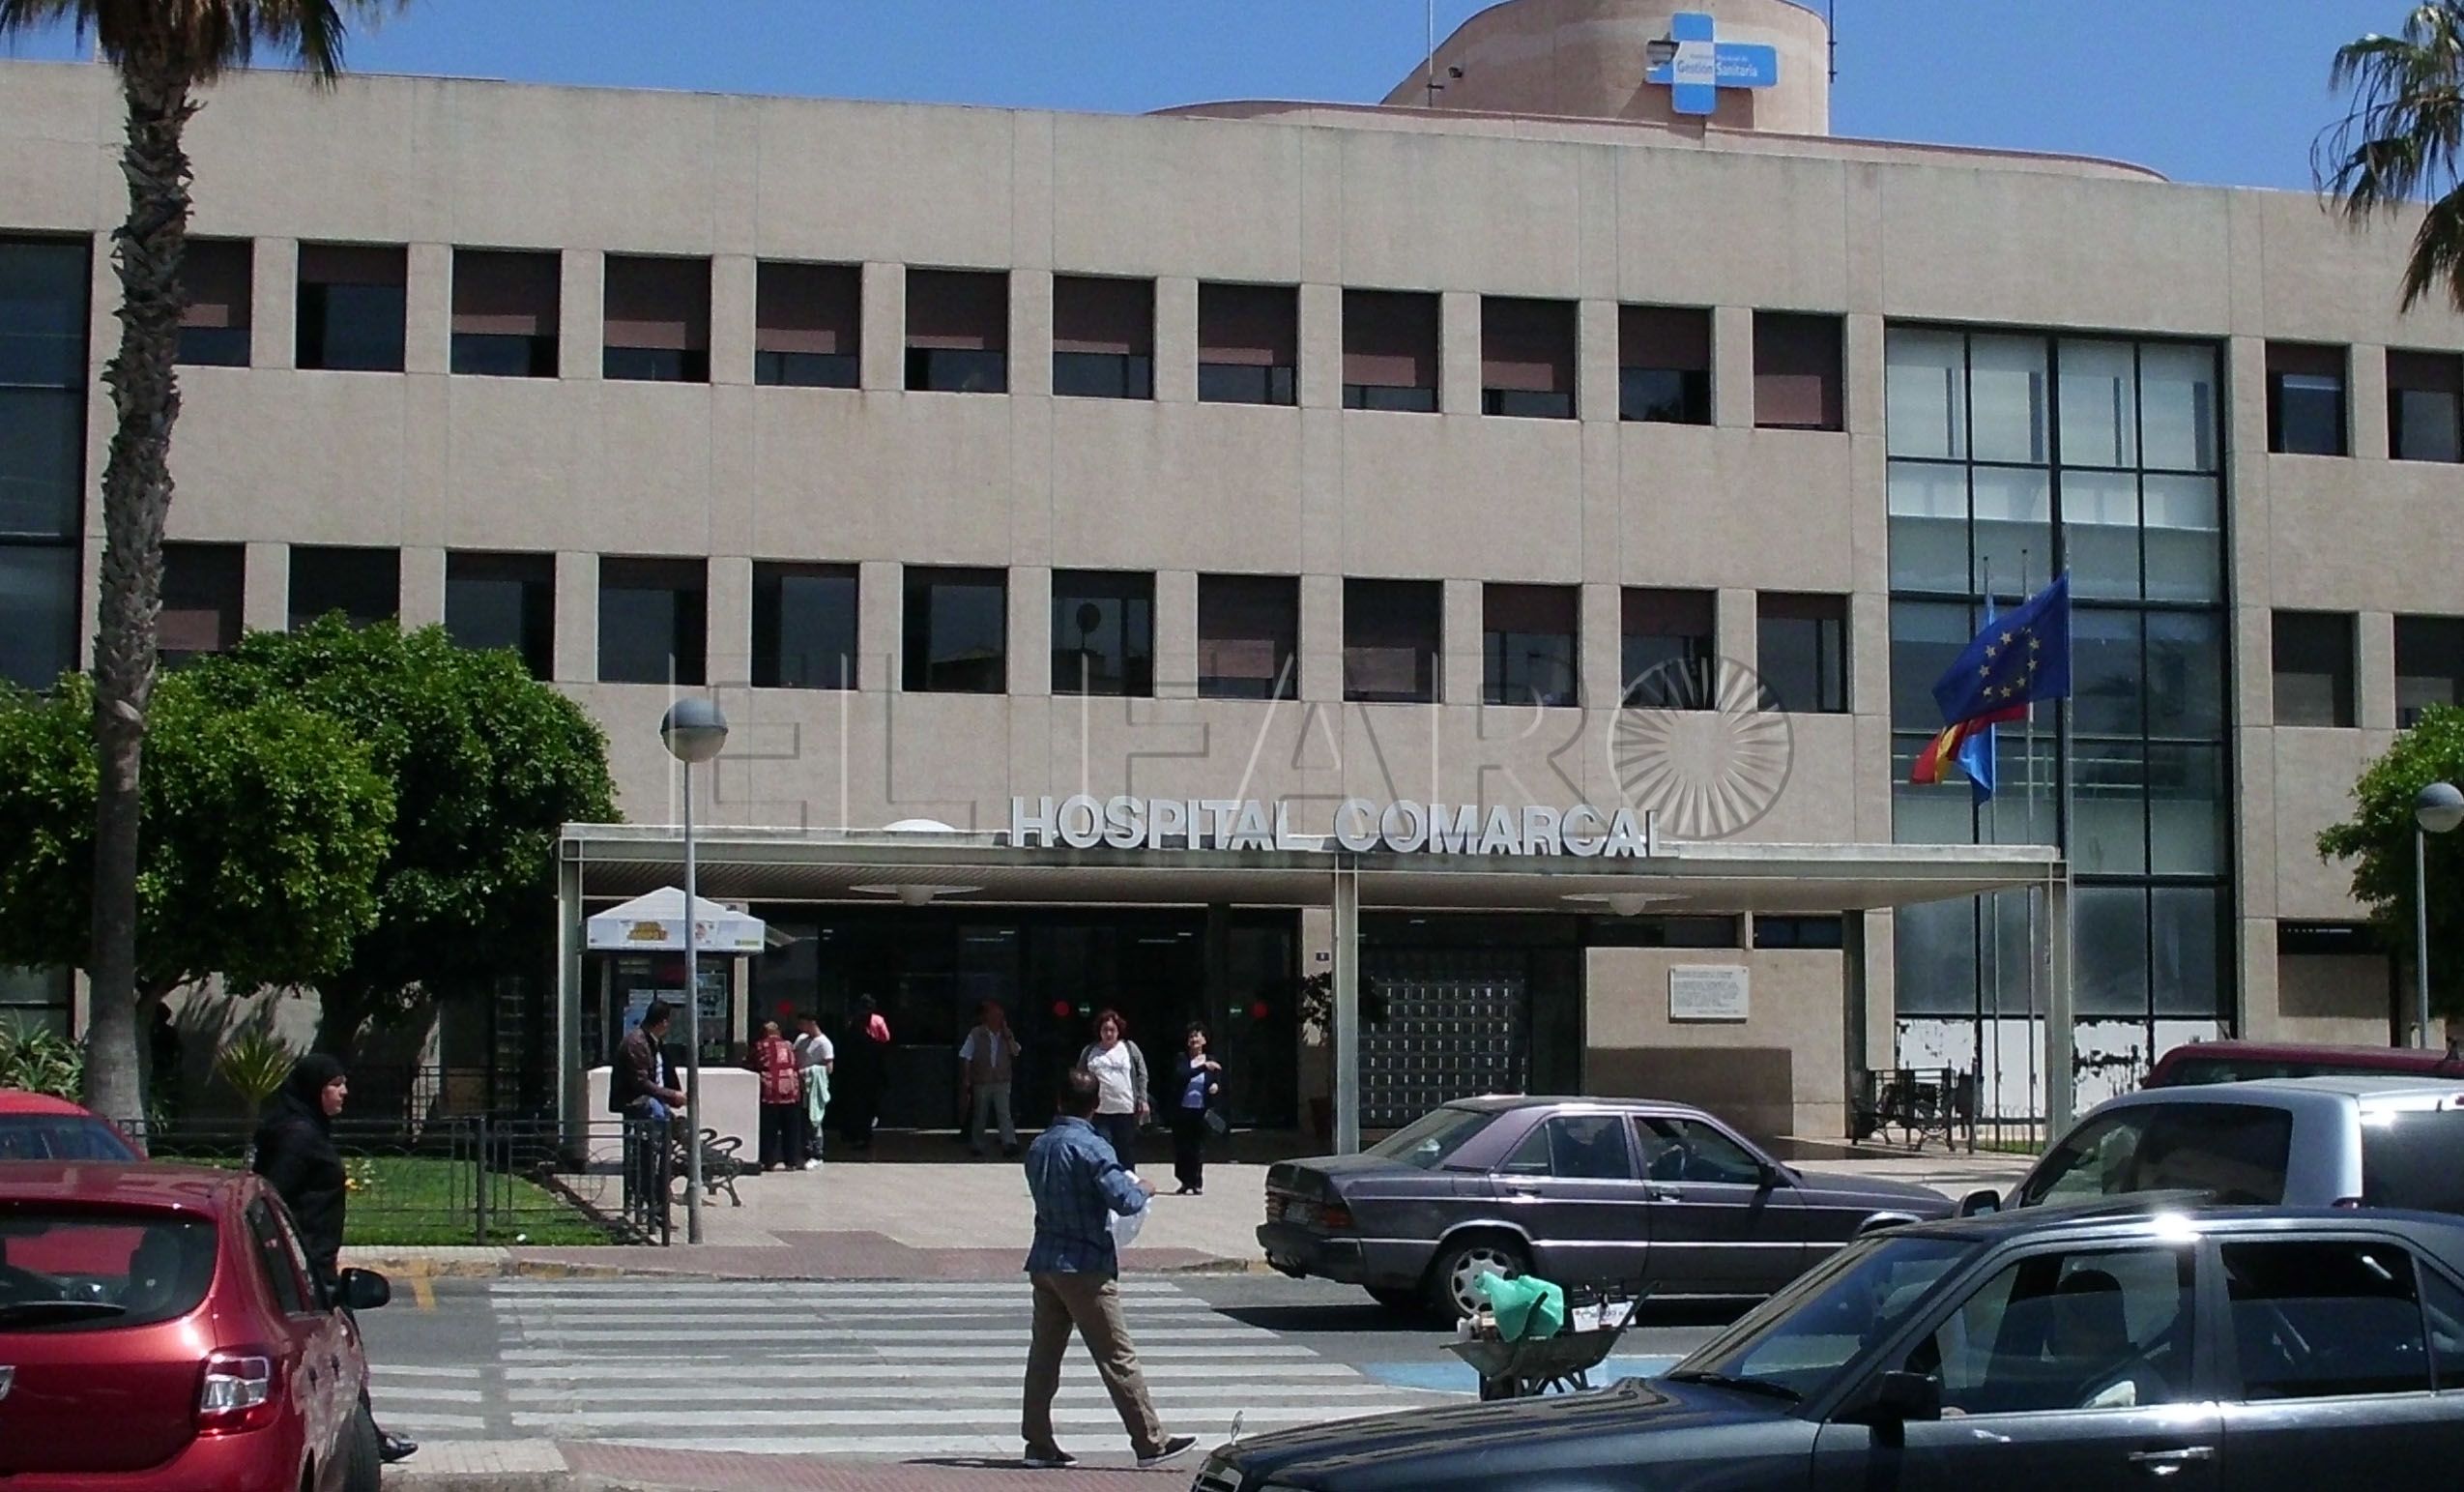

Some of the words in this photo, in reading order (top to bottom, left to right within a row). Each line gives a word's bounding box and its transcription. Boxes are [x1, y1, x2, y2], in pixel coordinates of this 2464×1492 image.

[1716, 61, 1757, 77] Sanitaria
[1012, 795, 1307, 851] HOSPITAL
[1334, 800, 1677, 858] COMARCAL
